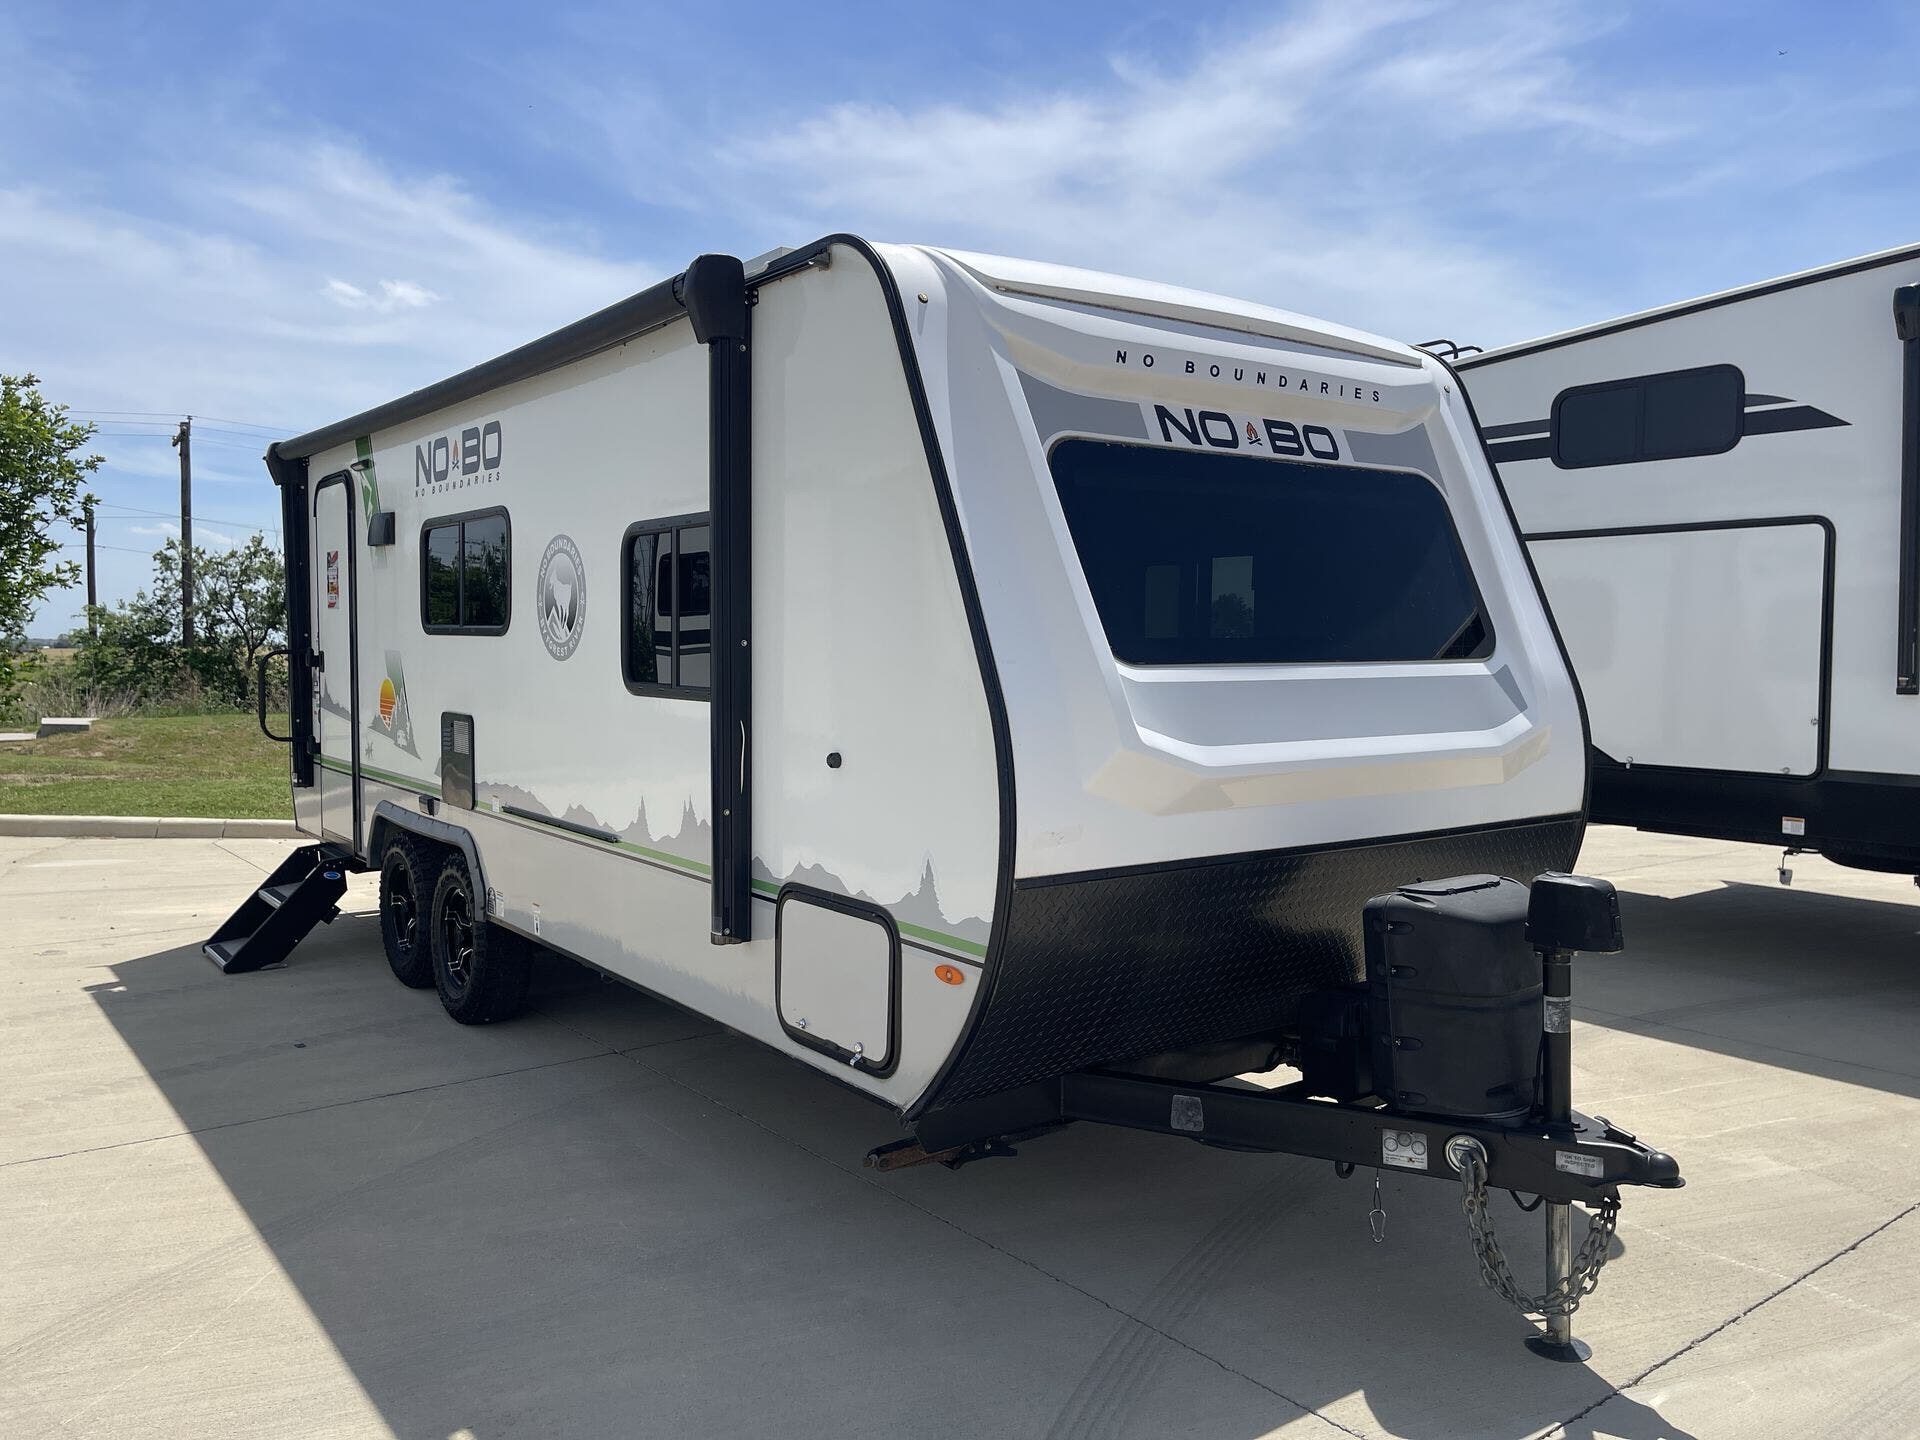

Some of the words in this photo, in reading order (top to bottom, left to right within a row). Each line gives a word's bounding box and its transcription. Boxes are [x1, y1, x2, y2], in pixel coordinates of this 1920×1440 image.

[1116, 350, 1154, 368] NO
[1185, 361, 1380, 402] BOUNDARIES
[415, 487, 426, 498] NO
[432, 471, 501, 494] BOUNDARIES
[546, 538, 583, 576] BOUNDARIES
